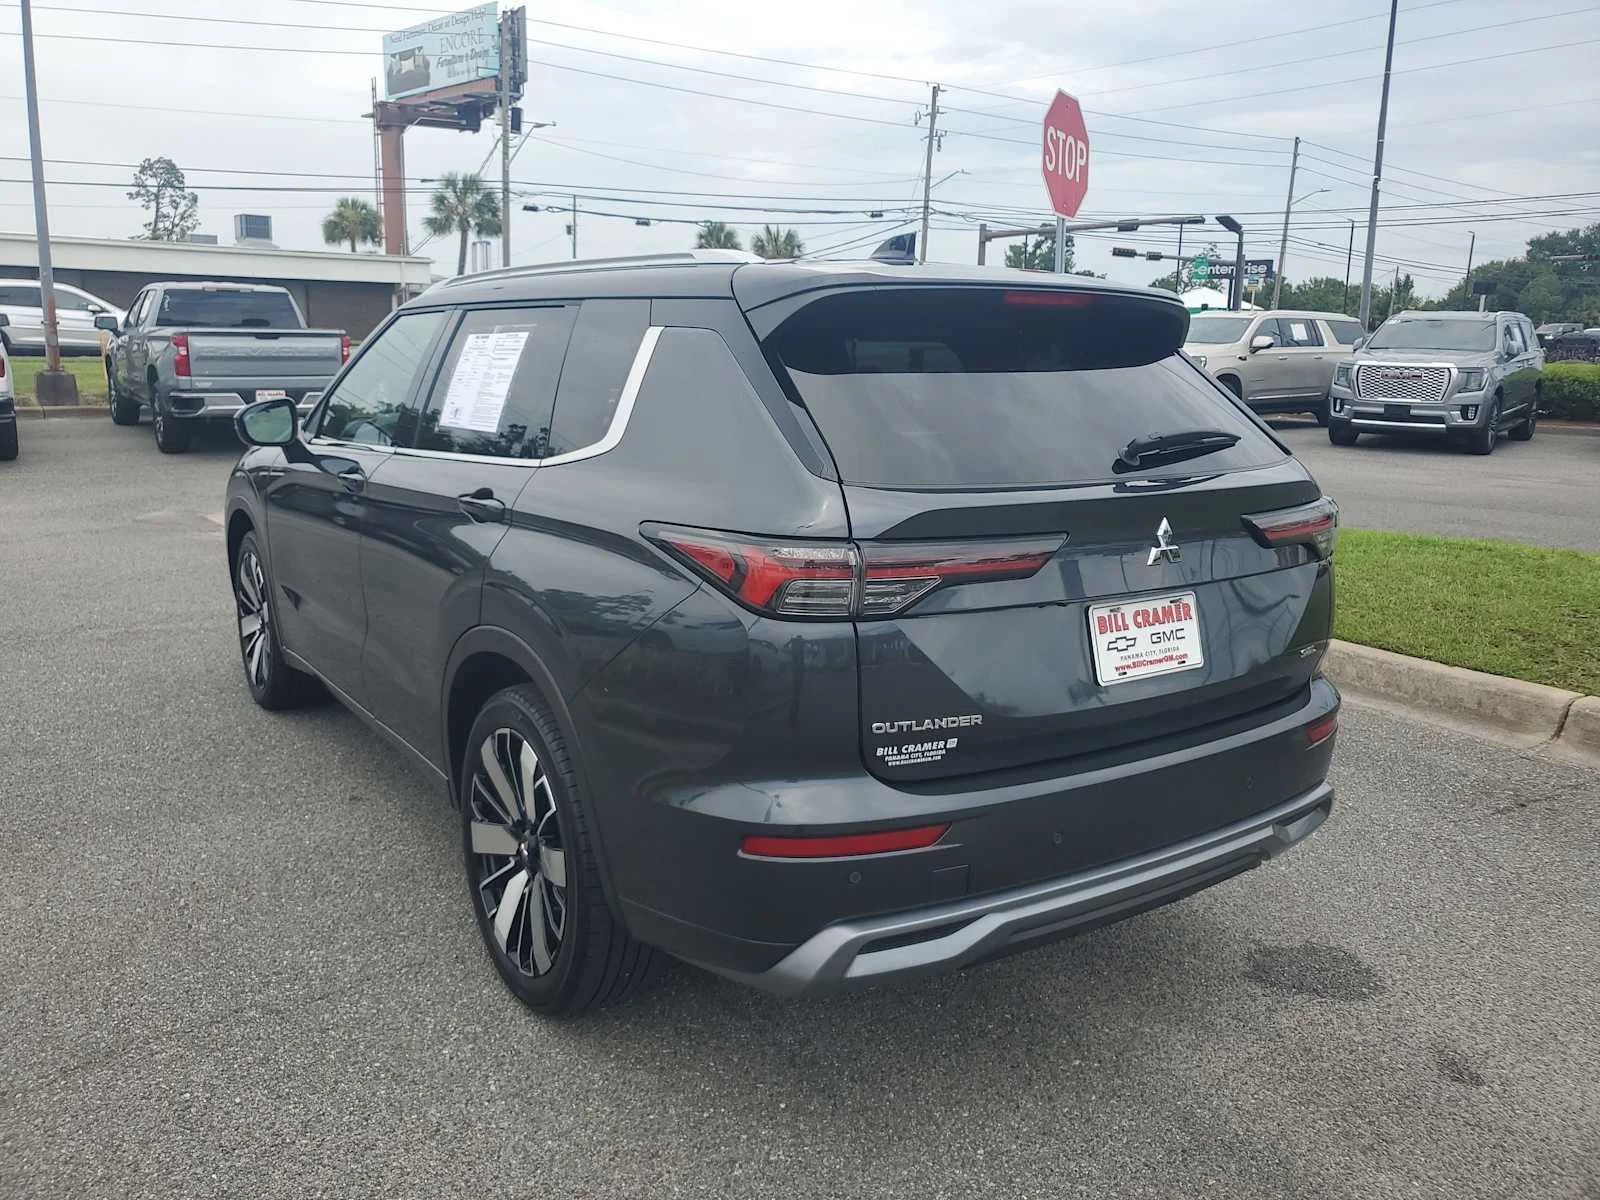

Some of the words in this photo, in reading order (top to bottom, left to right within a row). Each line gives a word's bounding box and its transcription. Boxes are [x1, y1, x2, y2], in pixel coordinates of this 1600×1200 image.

[440, 27, 484, 54] ENCORE
[1045, 126, 1087, 183] STOP
[1197, 262, 1268, 277] enterrise
[1097, 613, 1129, 634] BILL
[1133, 603, 1192, 628] CRAMER
[1150, 628, 1186, 645] GMC
[1120, 652, 1143, 661] PANAMA
[1159, 646, 1179, 655] FLORIDA
[871, 715, 982, 733] OUTLANDER
[876, 746, 899, 757] BILL
[901, 740, 946, 754] CRAMER
